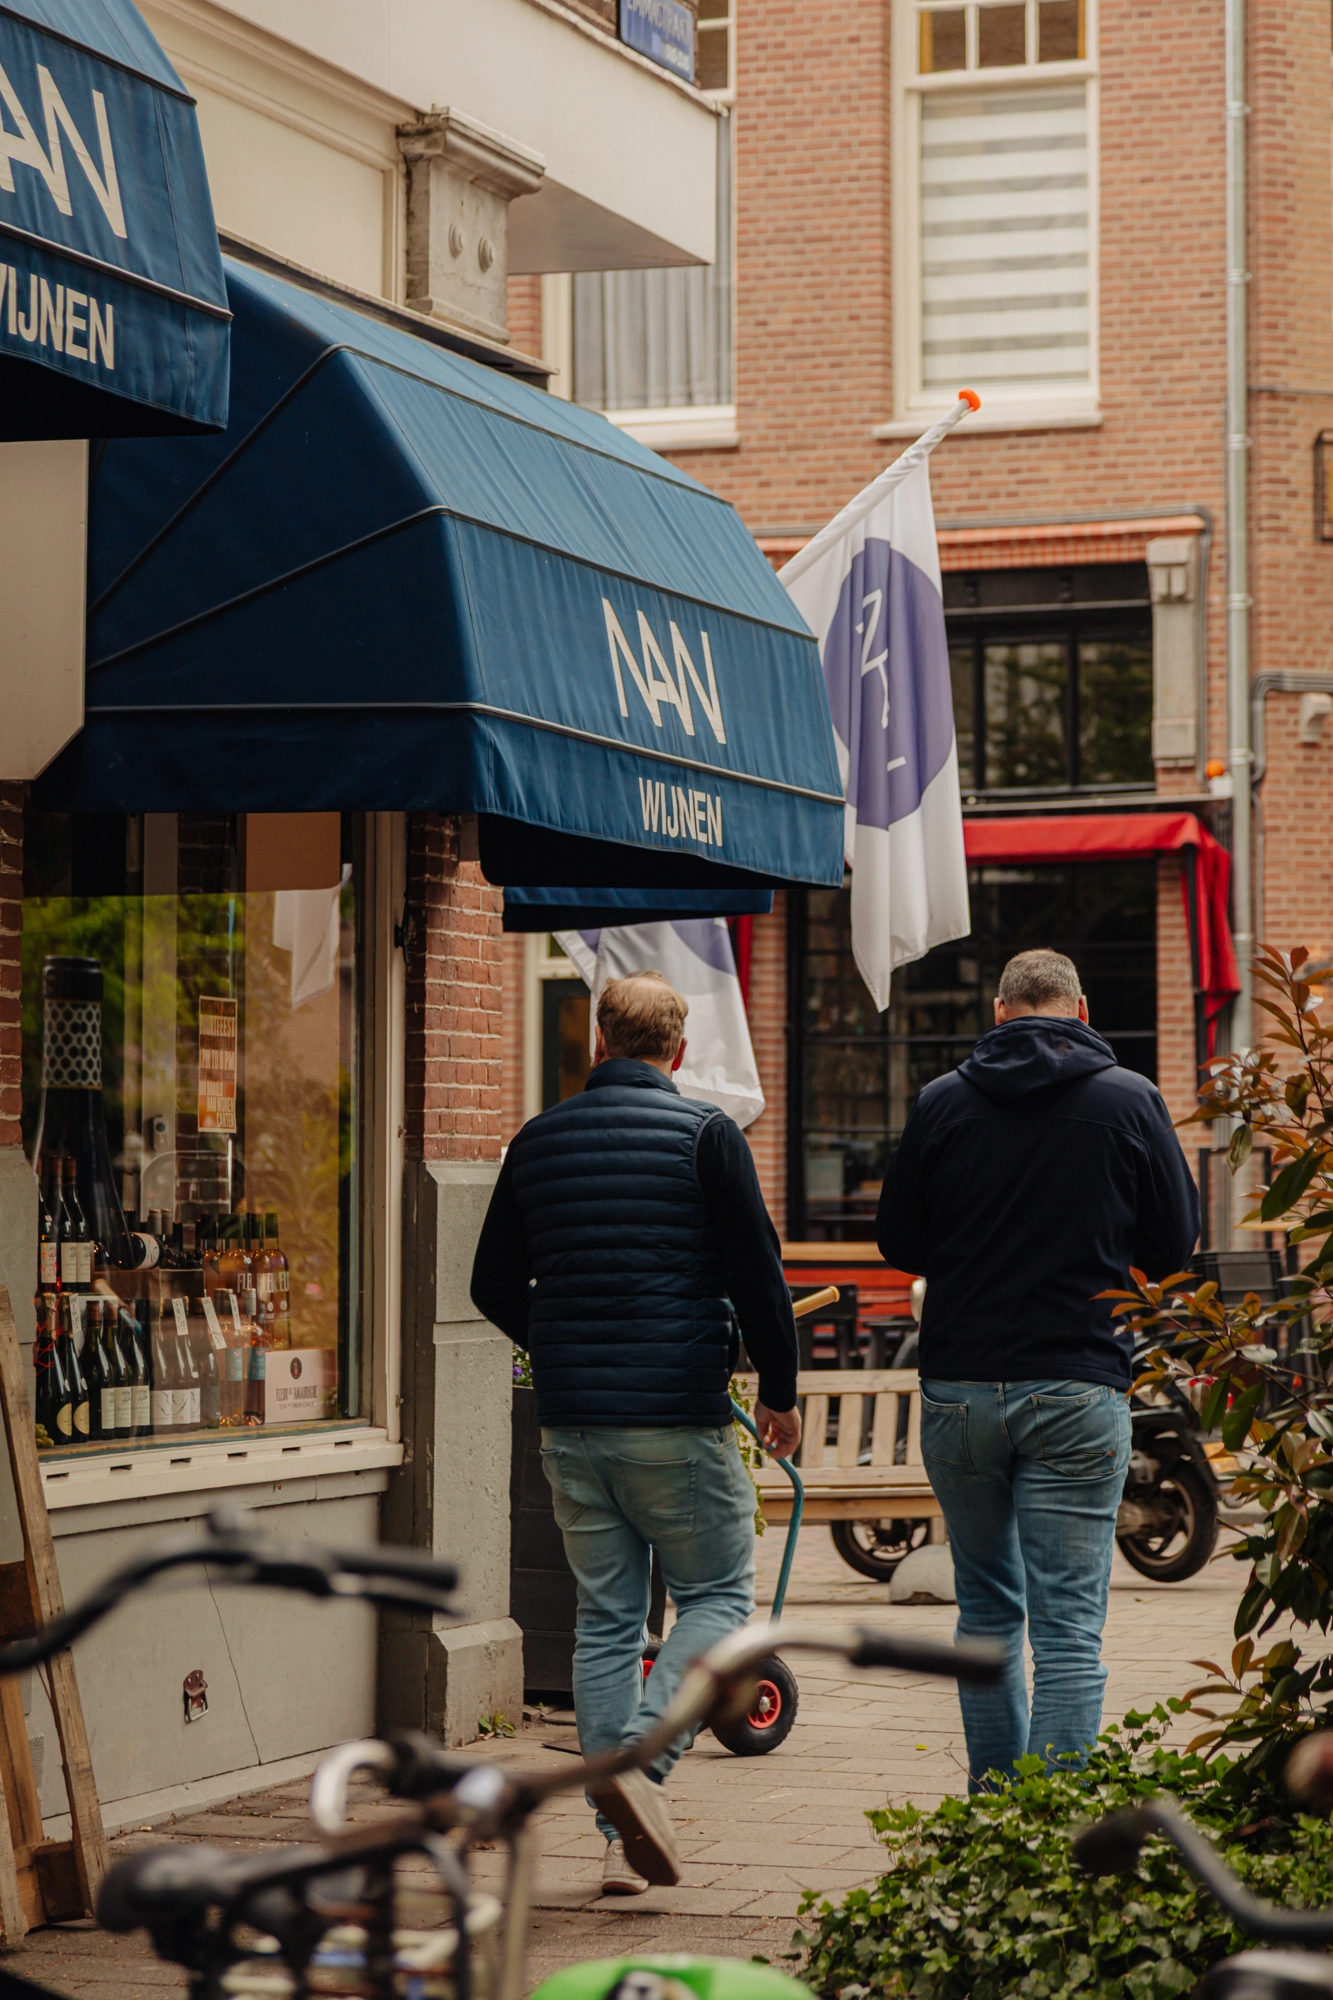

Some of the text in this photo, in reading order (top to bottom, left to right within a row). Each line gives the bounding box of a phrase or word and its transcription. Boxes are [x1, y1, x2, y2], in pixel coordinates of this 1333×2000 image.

[602, 597, 727, 745] NAN
[638, 777, 724, 848] WIJNEN
[225, 1050, 235, 1070] PM
[292, 1401, 314, 1409] PROVENCE
